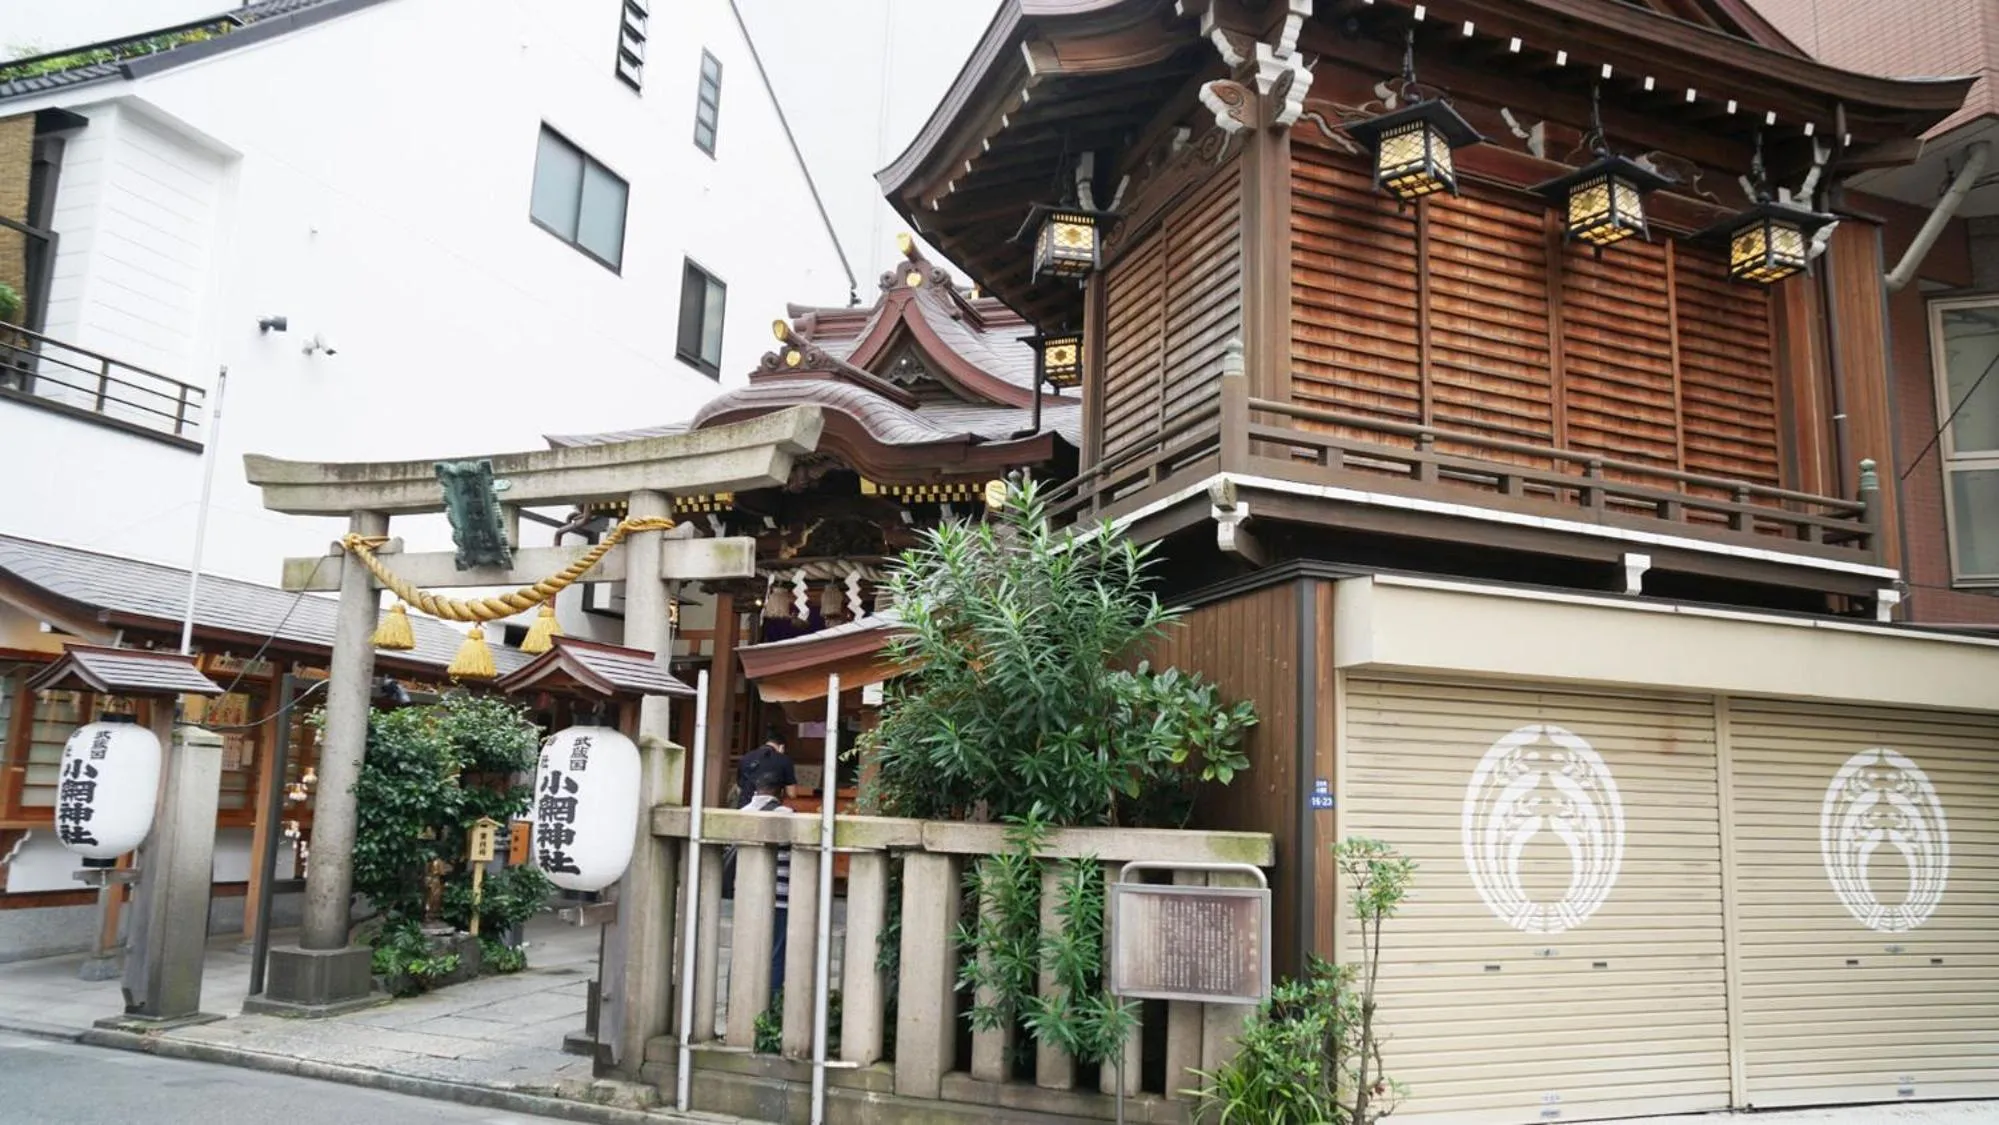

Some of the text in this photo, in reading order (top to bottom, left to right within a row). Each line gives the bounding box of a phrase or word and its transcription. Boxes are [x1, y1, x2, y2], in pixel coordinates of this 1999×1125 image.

[569, 736, 592, 771] 武蔵国
[59, 758, 98, 846] 小網神社
[537, 769, 581, 875] 小網神社
